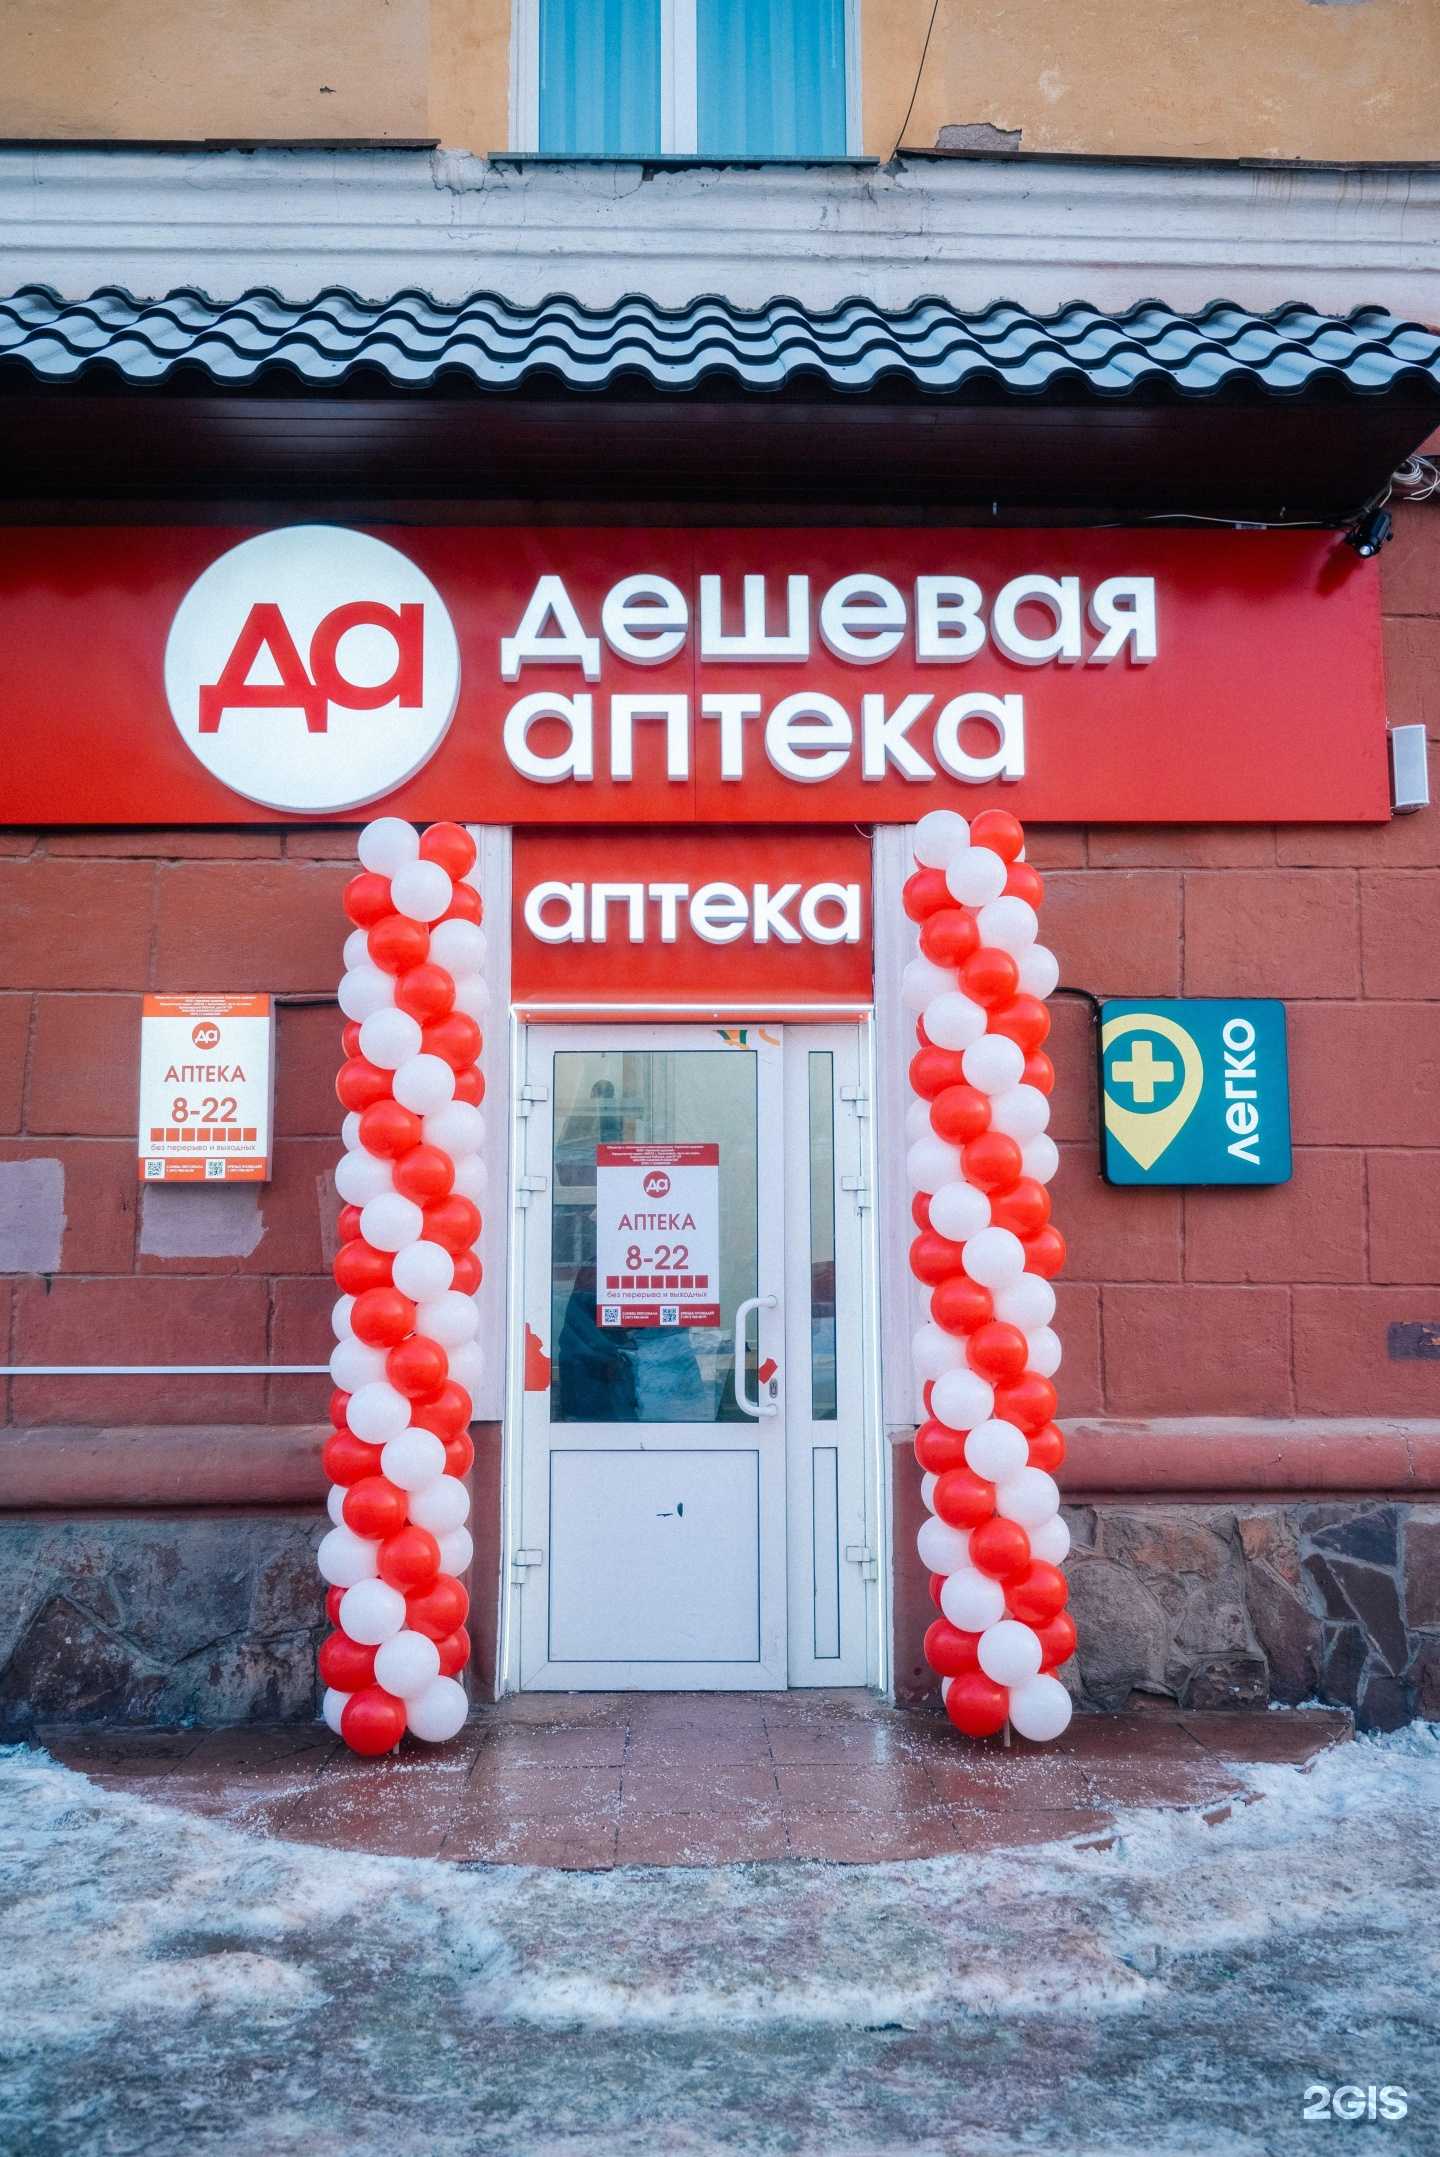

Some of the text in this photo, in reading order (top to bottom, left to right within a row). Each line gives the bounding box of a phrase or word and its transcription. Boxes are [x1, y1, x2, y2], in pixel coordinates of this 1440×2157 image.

[503, 691, 1026, 784] аптека
[524, 881, 862, 944] аптека
[164, 1065, 246, 1083] АПТЕКА
[171, 1096, 238, 1123] 8-22
[617, 1213, 697, 1231] АПТЕКА
[625, 1244, 689, 1271] 8-22
[622, 1292, 662, 1300] перерыва
